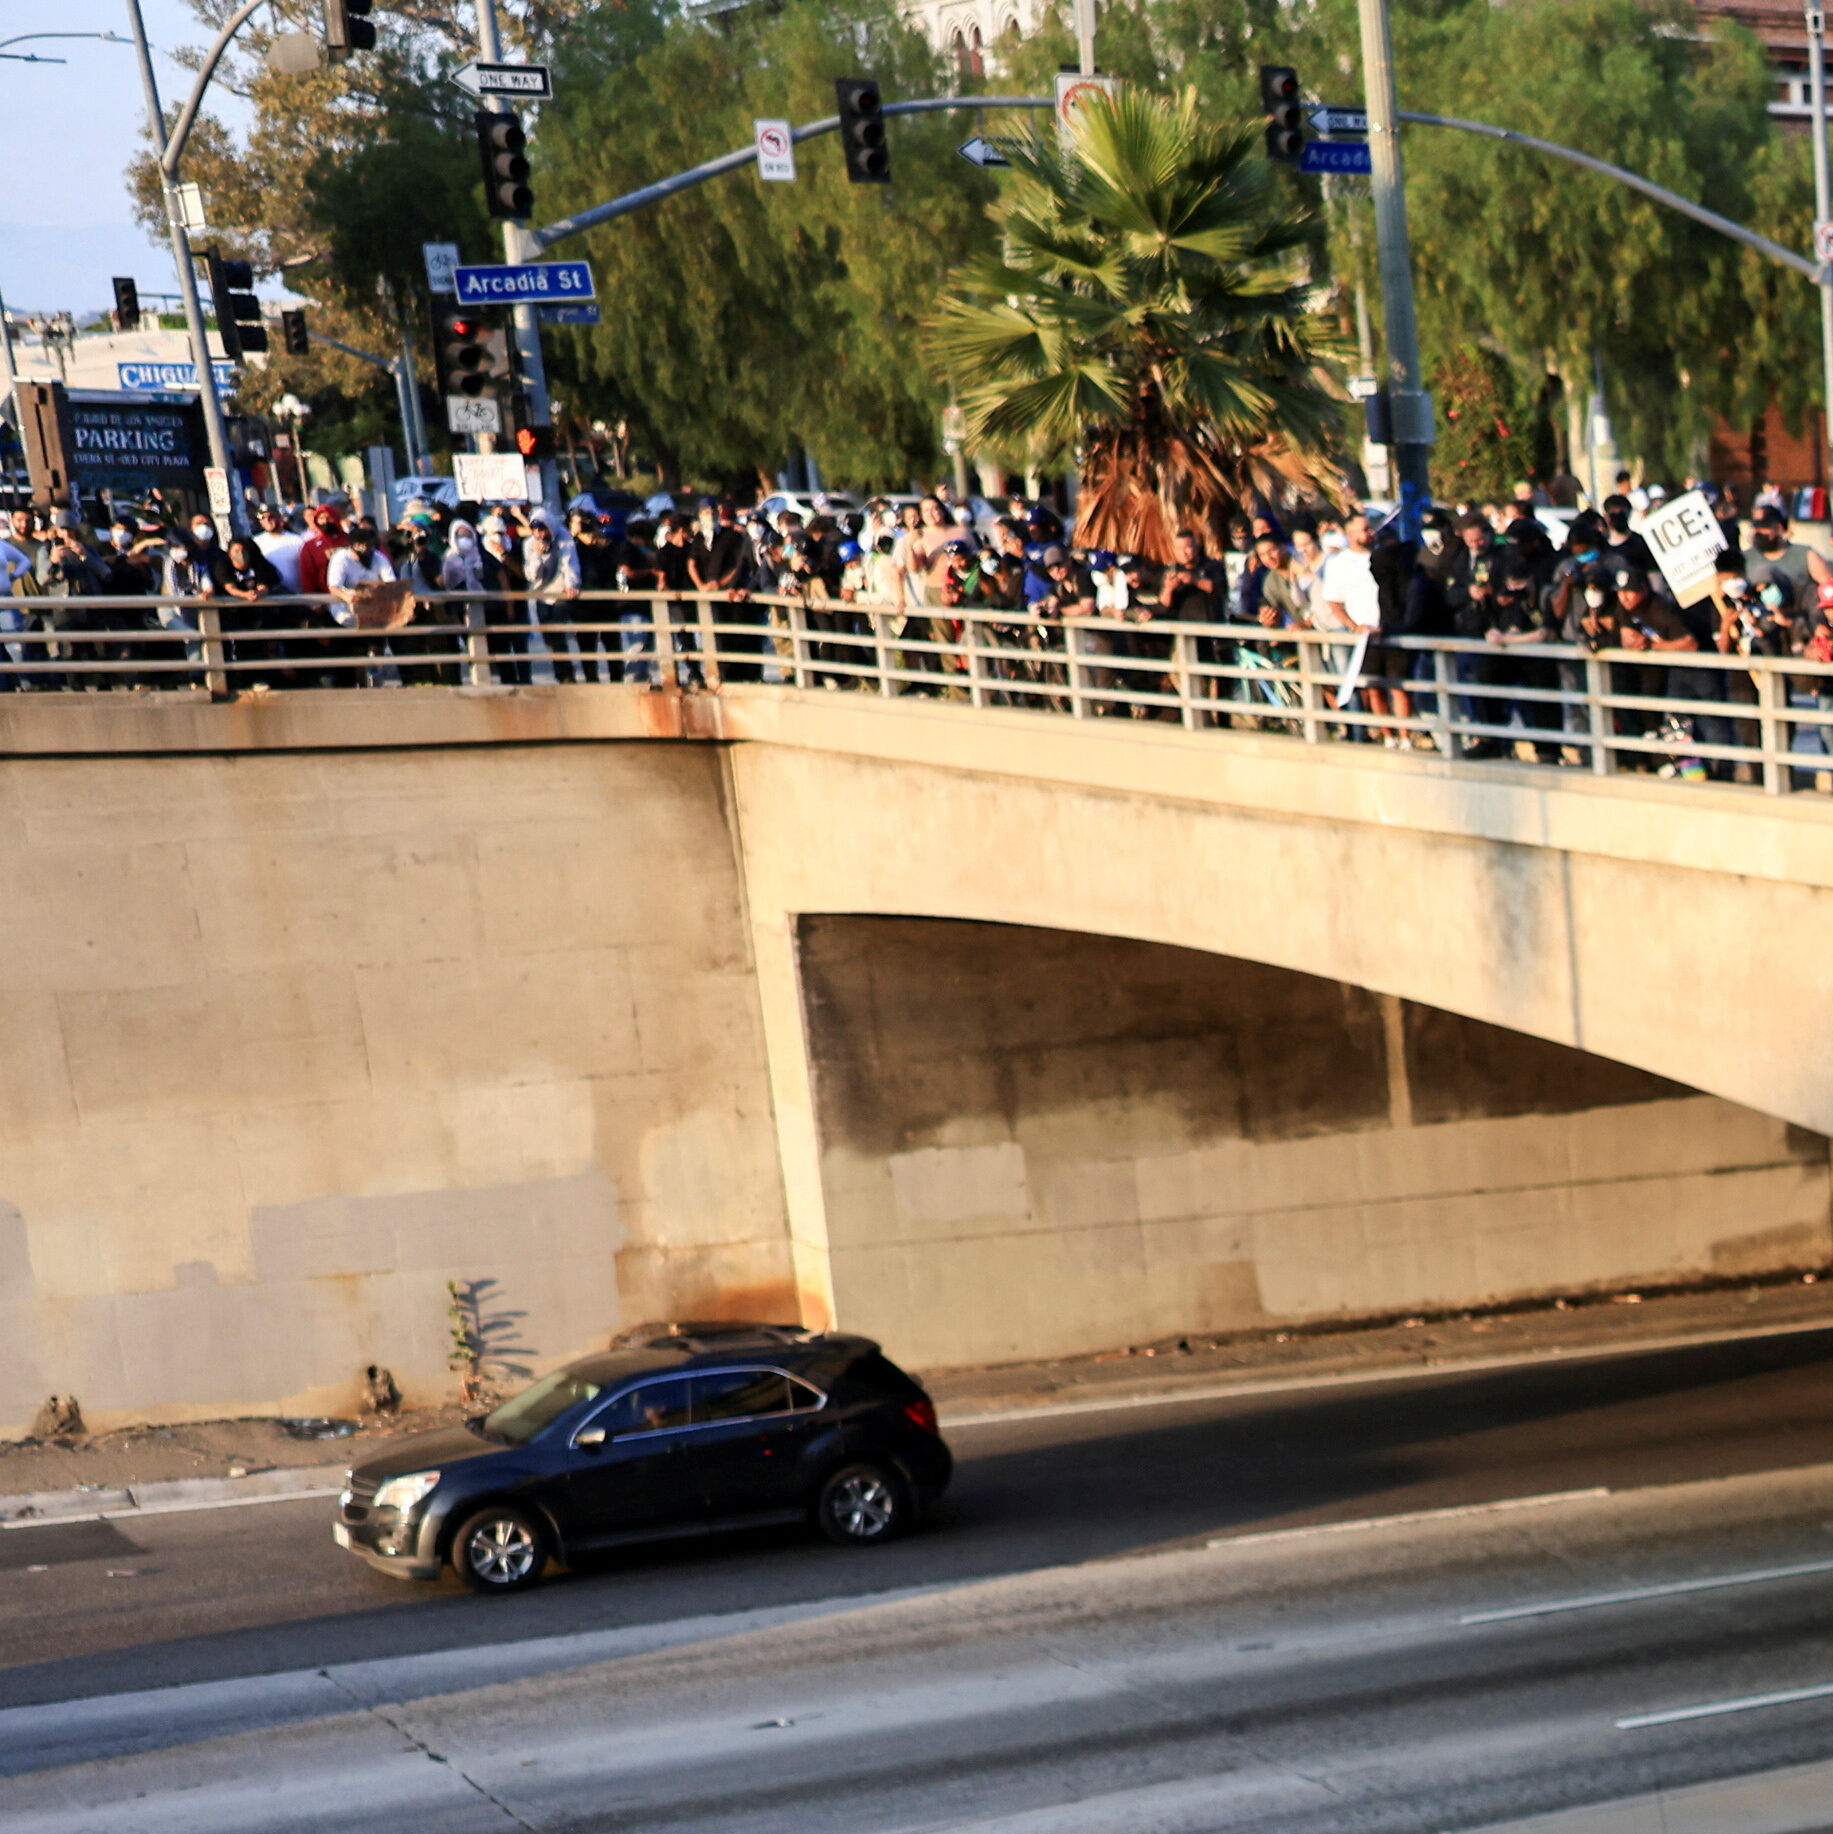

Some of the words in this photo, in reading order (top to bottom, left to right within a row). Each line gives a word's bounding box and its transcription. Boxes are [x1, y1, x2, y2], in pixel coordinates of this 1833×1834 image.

[480, 74, 505, 86] ONE
[511, 76, 538, 88] WAY
[465, 271, 549, 294] Arcadia
[558, 270, 583, 290] St
[74, 428, 175, 452] PARKING
[1651, 508, 1710, 554] ICE:
